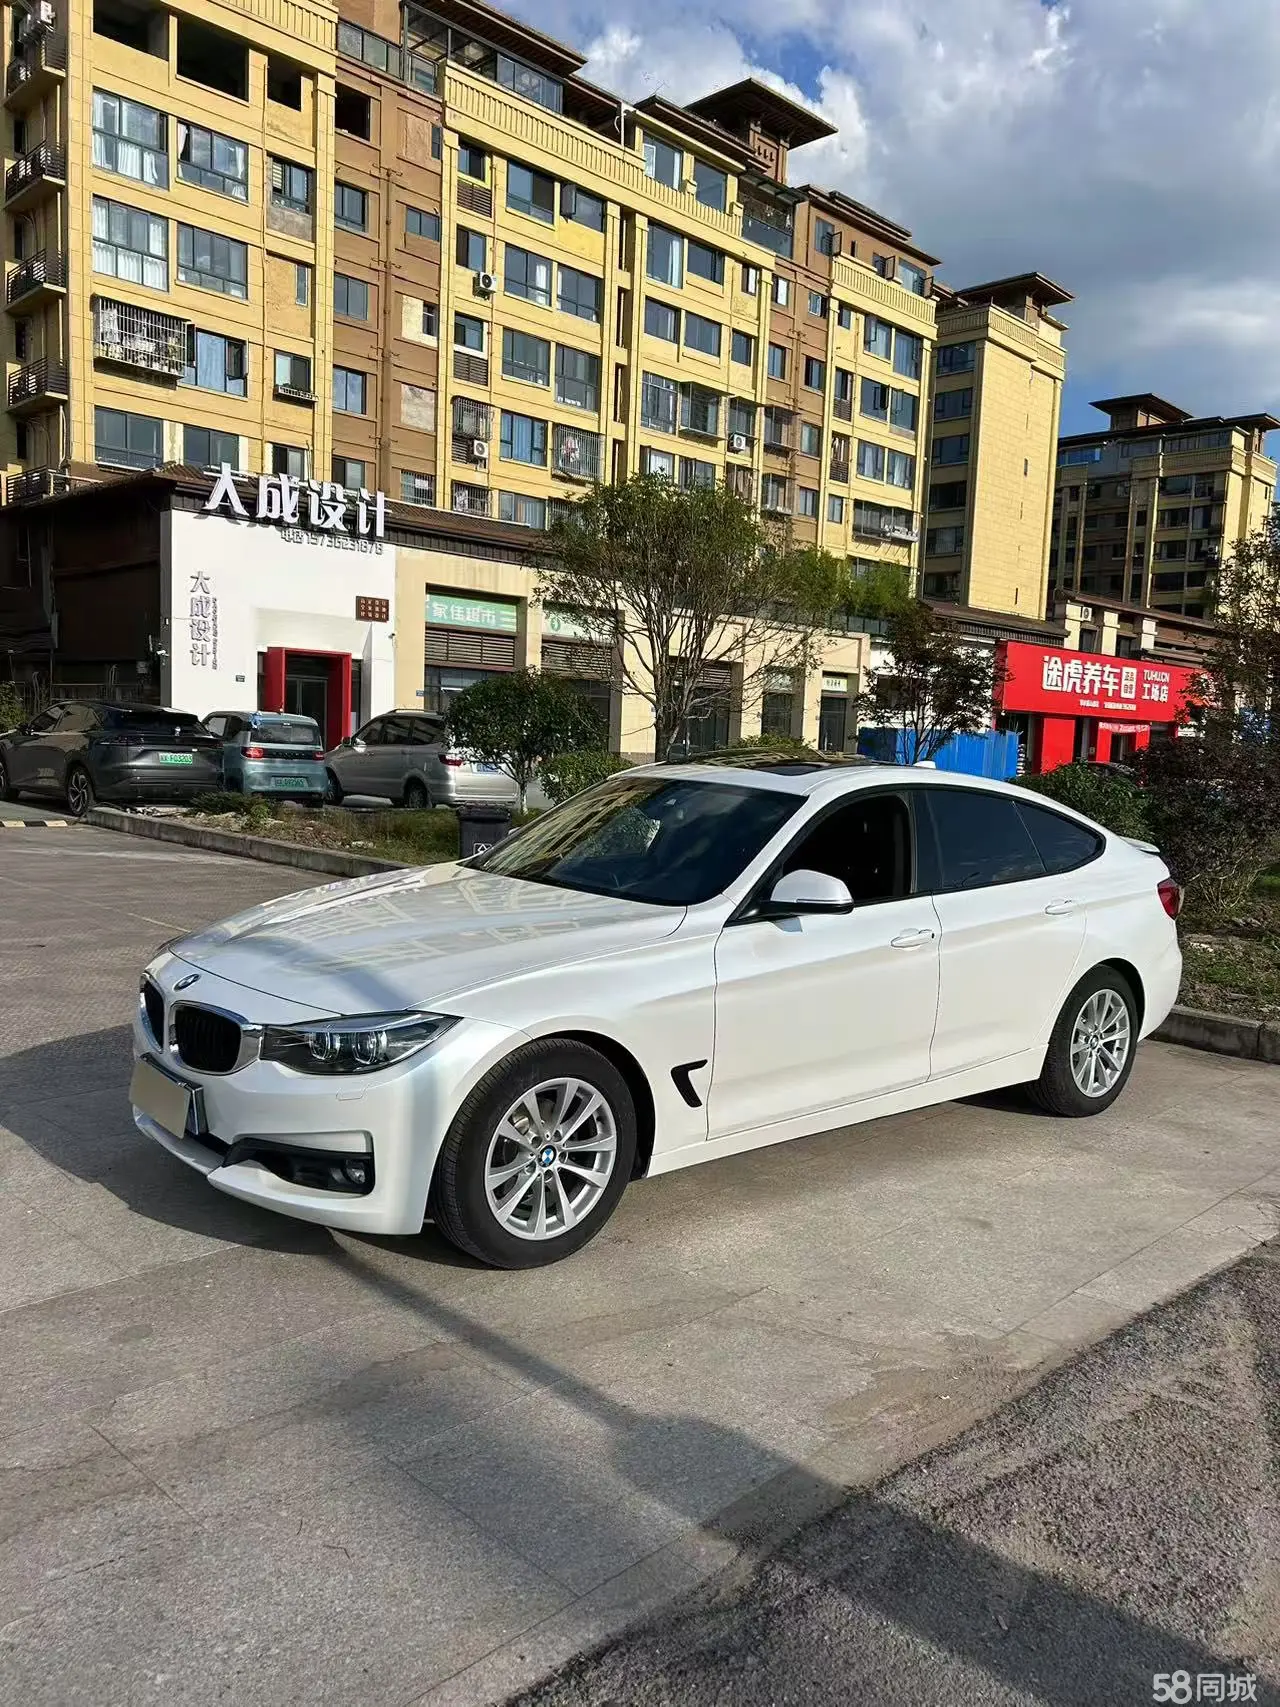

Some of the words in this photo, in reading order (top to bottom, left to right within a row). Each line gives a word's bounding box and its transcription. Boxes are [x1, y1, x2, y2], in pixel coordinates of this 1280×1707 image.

[203, 462, 392, 537] 大成设计
[190, 571, 211, 667] 大成设计
[432, 601, 496, 626] 家佳超市
[1042, 655, 1121, 697] 途虎养车
[1141, 683, 1169, 703] 工场店
